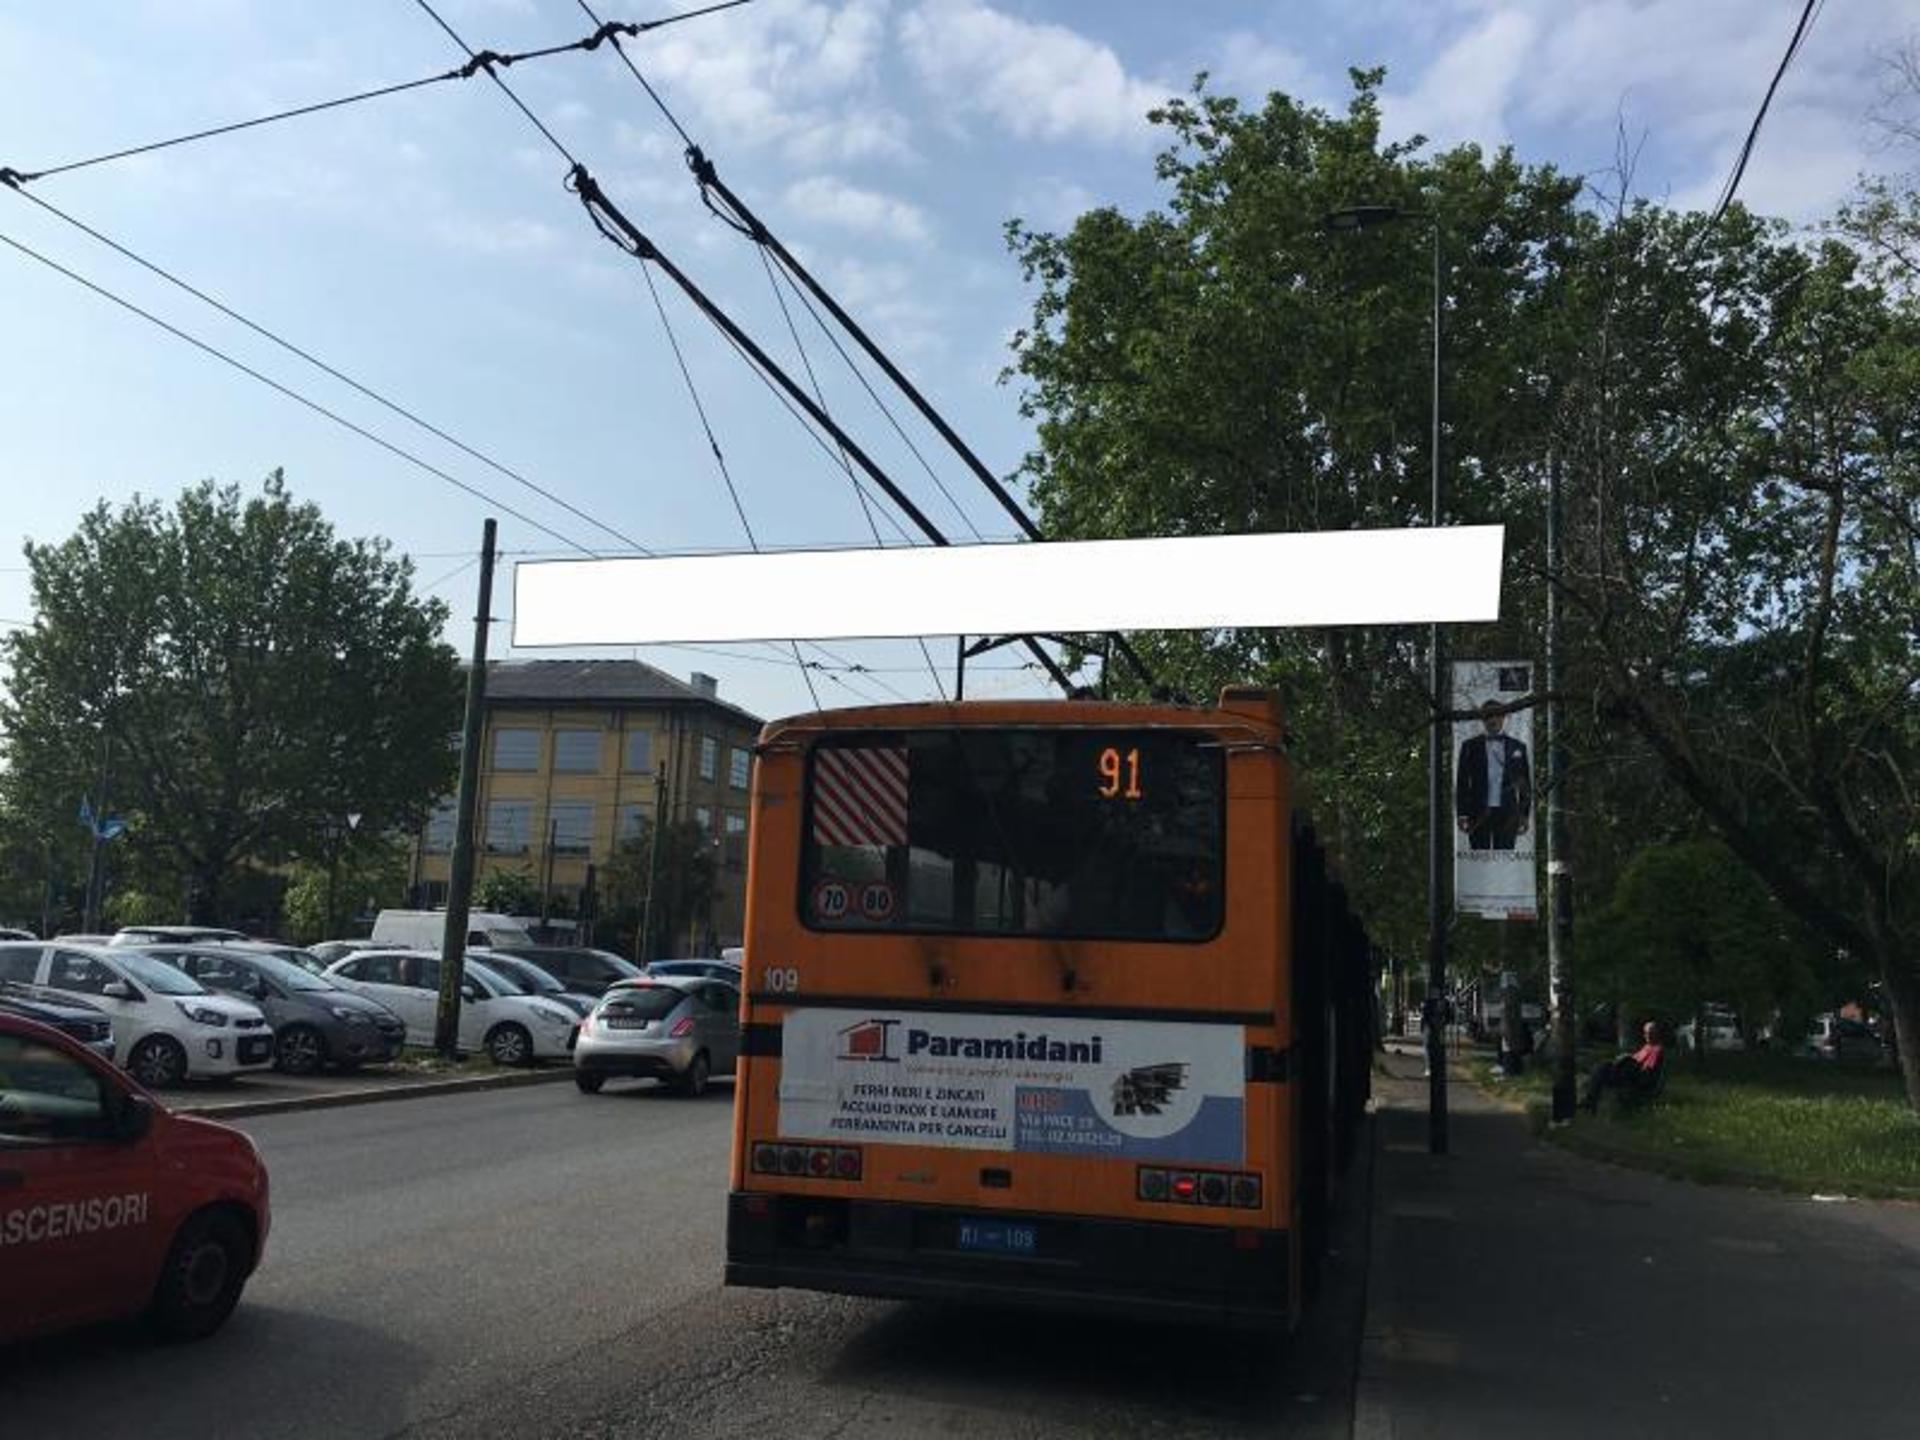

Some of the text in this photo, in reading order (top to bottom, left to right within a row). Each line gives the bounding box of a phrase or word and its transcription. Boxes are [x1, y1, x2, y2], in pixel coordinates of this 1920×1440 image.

[1099, 748, 1141, 798] 91
[824, 889, 844, 910] 70
[865, 890, 889, 911] 80
[765, 966, 798, 993] 109
[907, 1029, 1102, 1064] Paramidani
[892, 1086, 922, 1098] NERI
[936, 1088, 985, 1102] ZINCATI
[895, 1103, 927, 1117] INOX
[830, 1118, 1007, 1139] FERRAMENTA PER CANCELLI
[0, 1191, 148, 1246] SCENSORI
